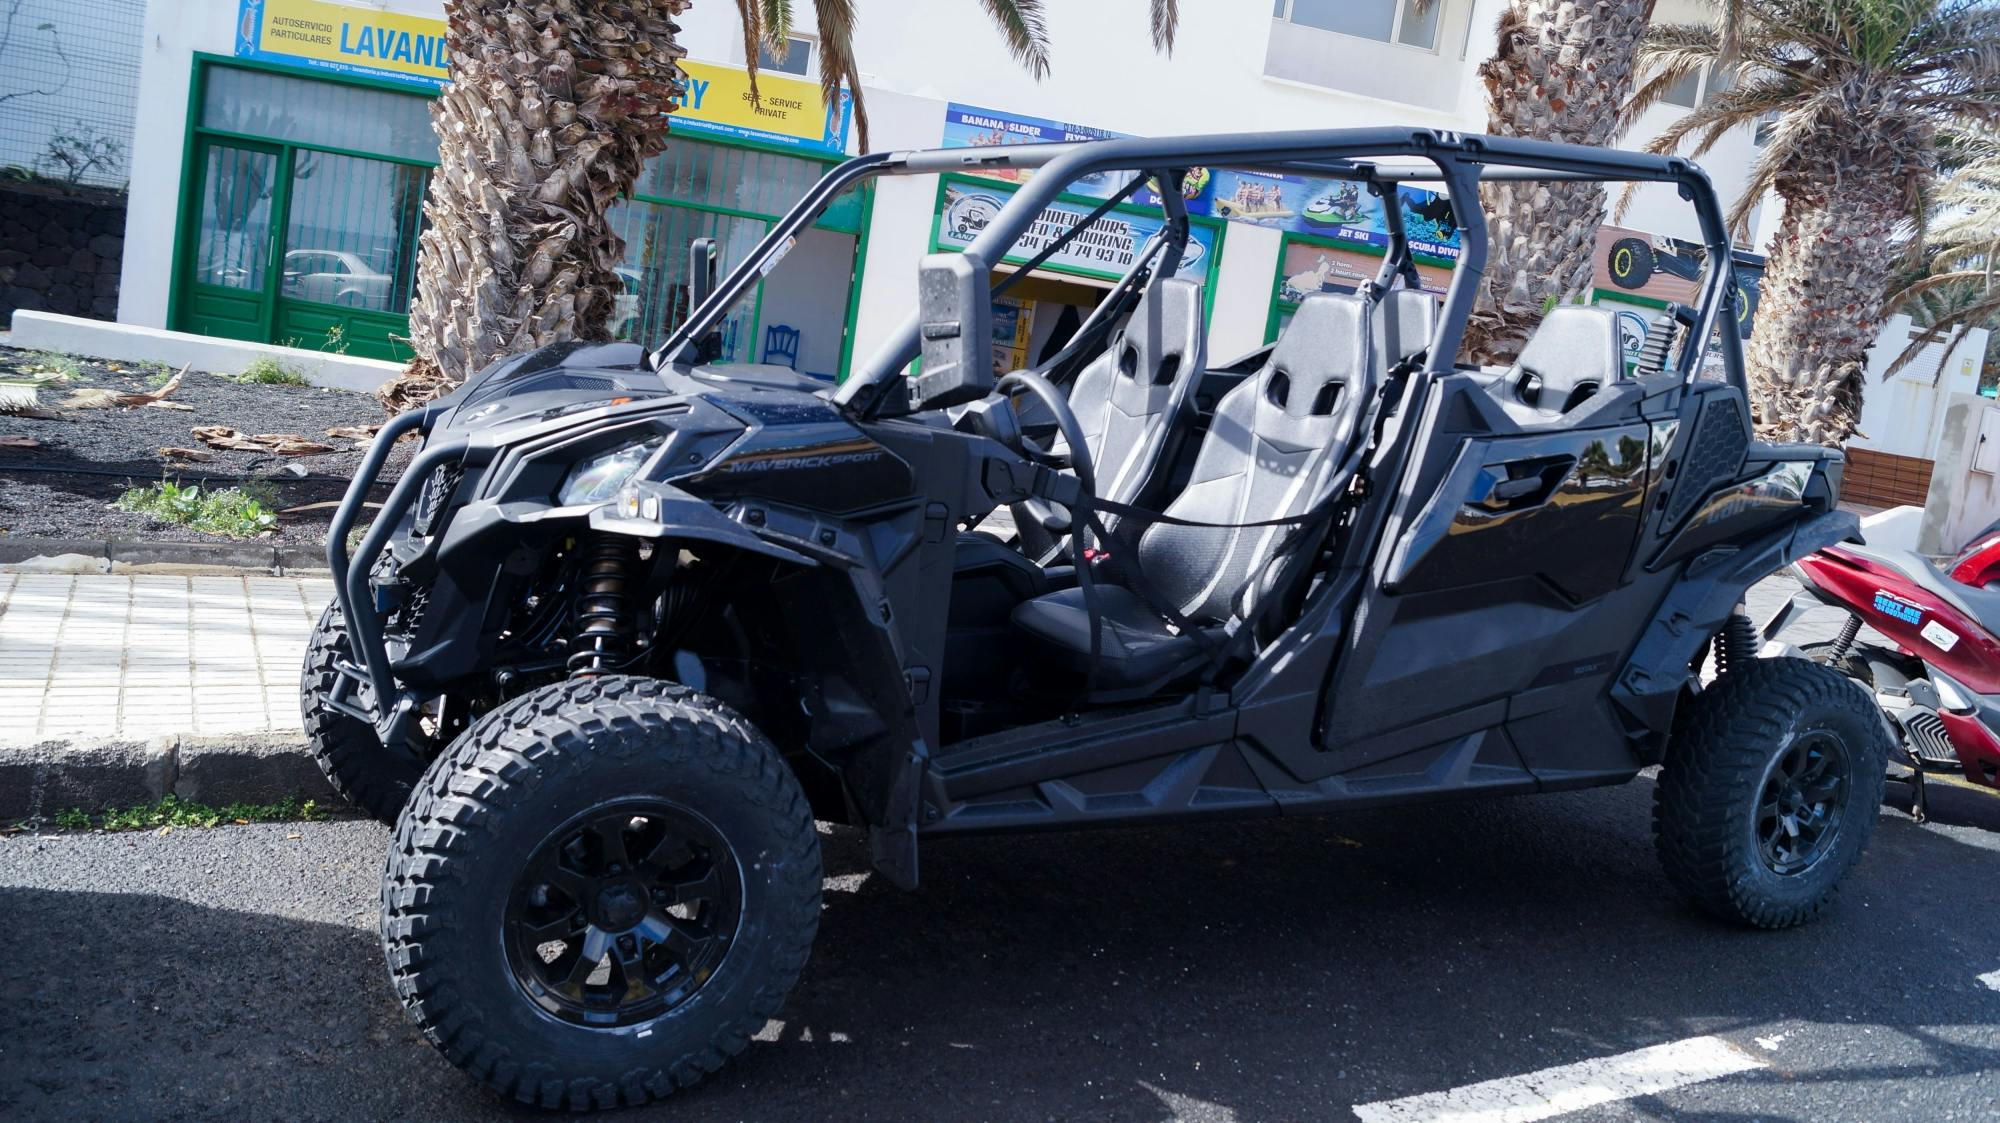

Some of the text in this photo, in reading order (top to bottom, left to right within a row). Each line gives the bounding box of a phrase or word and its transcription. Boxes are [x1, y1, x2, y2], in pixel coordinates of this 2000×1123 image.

[272, 16, 333, 33] AUTOSERVICIO
[271, 28, 332, 45] PARTICULARES
[340, 22, 450, 69] LAVAND
[742, 92, 762, 103] SEF
[769, 97, 802, 110] SERVICE
[754, 106, 787, 119] PRIVATE
[961, 114, 1041, 137] BANANA SLIDER
[1086, 215, 1129, 235] OURS
[1338, 228, 1369, 241] JET SKI
[950, 231, 976, 241] LANZ
[1030, 222, 1049, 236] FO
[1073, 230, 1133, 251] OOKING:
[1043, 239, 1070, 254] 69
[1075, 244, 1092, 258] 74
[1096, 247, 1114, 261] 93
[1118, 251, 1133, 265] 18
[1408, 240, 1459, 257] SCUBA DIVI
[729, 451, 882, 473] MAVERICK SPORT
[1874, 594, 1903, 610] RENT
[1903, 605, 1922, 618] ME
